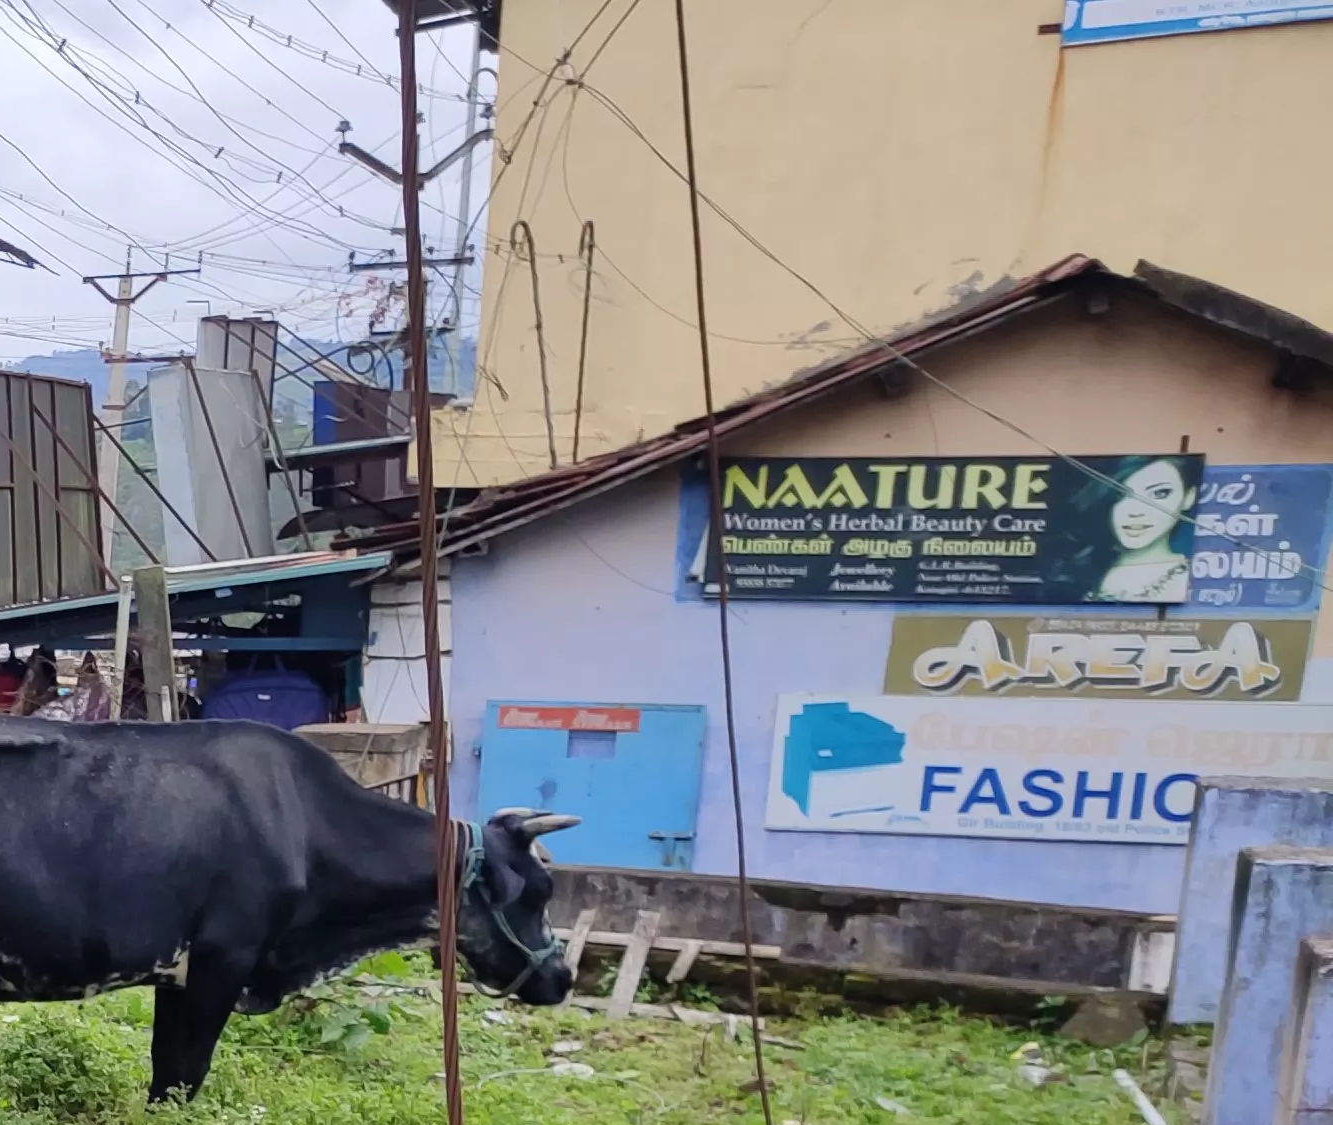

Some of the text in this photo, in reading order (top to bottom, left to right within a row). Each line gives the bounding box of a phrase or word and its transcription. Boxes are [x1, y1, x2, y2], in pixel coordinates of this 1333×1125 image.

[723, 463, 1049, 511] NAATURE
[723, 513, 1047, 537] Women's Herbal Beauty Care
[913, 619, 1282, 697] AREFA
